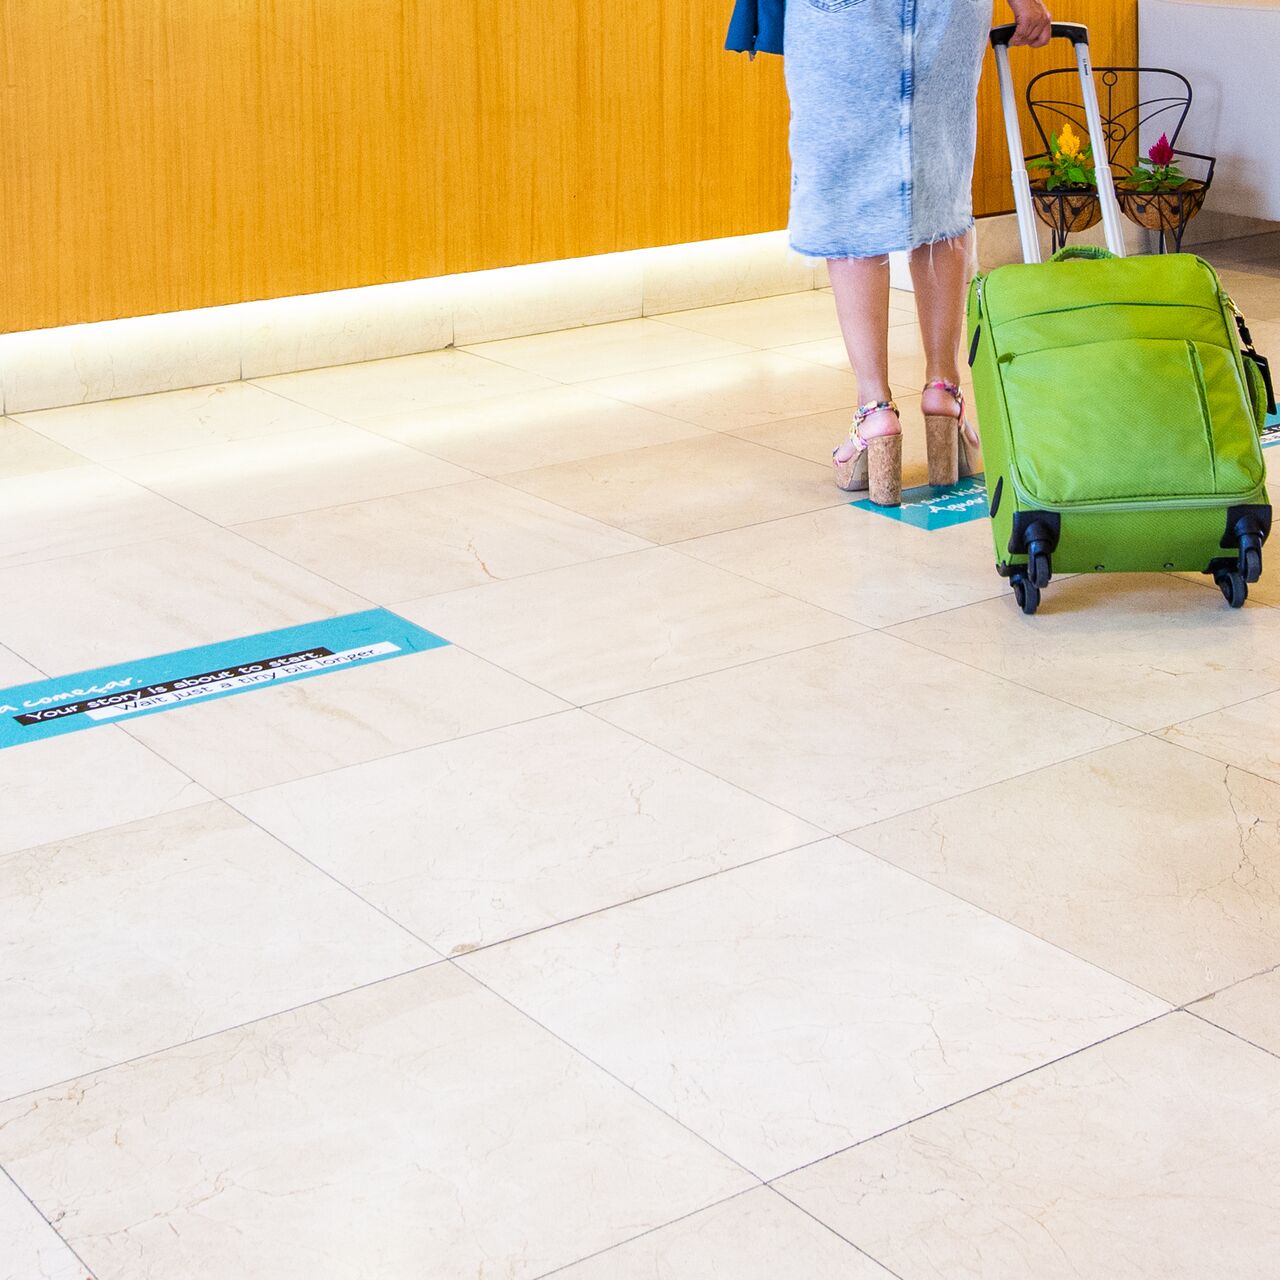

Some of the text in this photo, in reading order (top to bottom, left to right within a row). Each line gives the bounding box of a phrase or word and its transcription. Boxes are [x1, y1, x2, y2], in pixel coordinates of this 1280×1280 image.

[929, 493, 987, 513] Aguar
[23, 676, 143, 709] começar.
[26, 650, 323, 721] Your story is about to start.
[115, 696, 167, 711] Wait
[173, 686, 213, 701] just
[238, 671, 276, 684] tiny
[282, 662, 312, 675] bit
